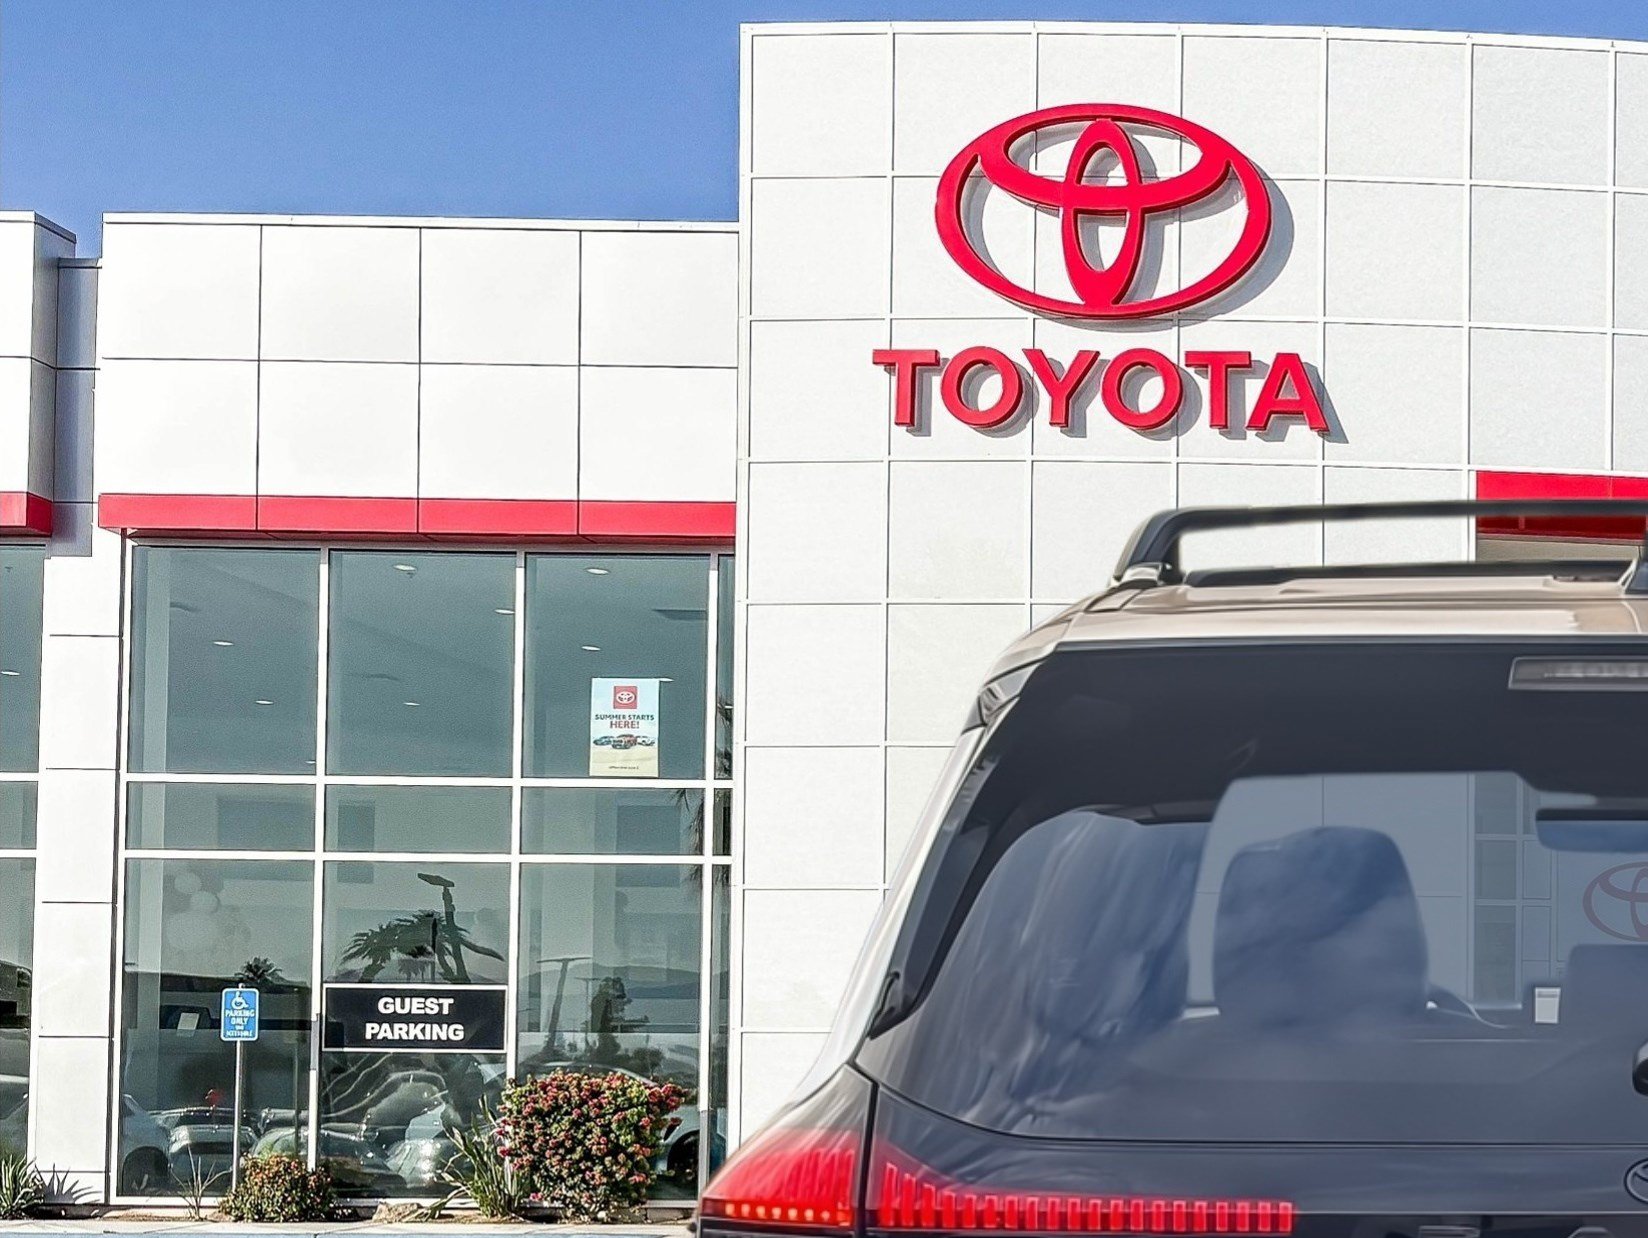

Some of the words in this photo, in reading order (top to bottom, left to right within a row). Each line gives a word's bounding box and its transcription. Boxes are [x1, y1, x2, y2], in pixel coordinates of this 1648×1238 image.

[872, 346, 1330, 432] TOYOTA
[628, 713, 655, 721] STARTS
[609, 720, 640, 729] HERE!
[377, 997, 454, 1015] GUEST
[225, 1009, 255, 1017] PARKING
[230, 1017, 248, 1025] ONLY
[365, 1022, 465, 1041] PARKING
